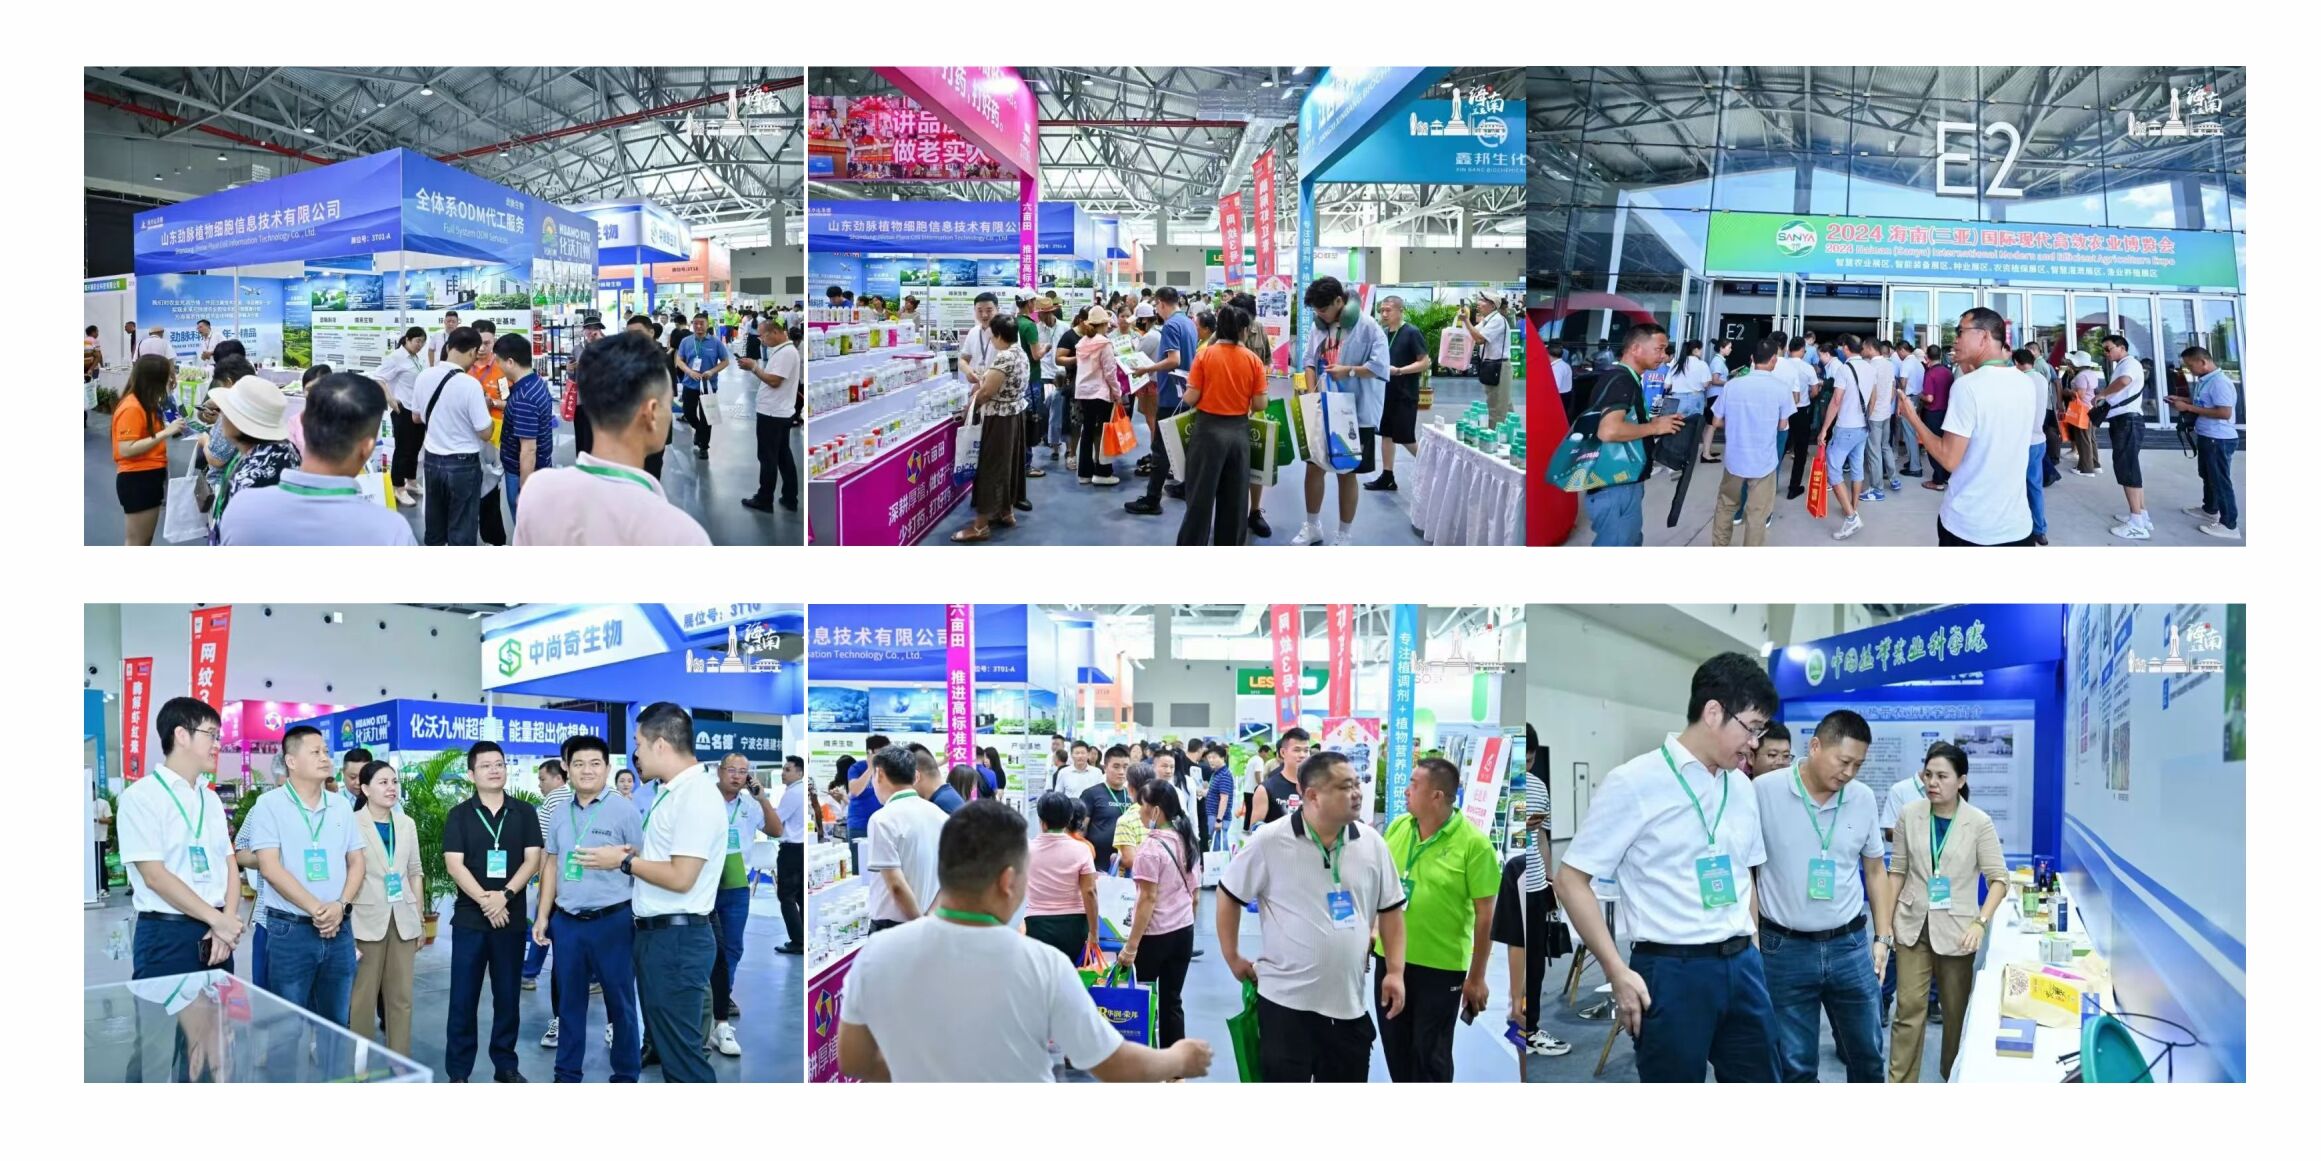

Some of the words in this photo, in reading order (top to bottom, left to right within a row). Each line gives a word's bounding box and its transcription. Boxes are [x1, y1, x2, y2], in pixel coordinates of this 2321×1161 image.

[892, 109, 955, 134] 讲品
[1456, 152, 1526, 167] 鑫邦生化
[1936, 120, 2024, 198] E2
[416, 187, 525, 235] 全体系ODM代工服务
[1022, 203, 1033, 231] 六亩田
[161, 199, 340, 246] 山东劲脉植物细胞信息技术有限公司
[828, 220, 1020, 233] 山东劲脉植物细胞信息技术有限公
[1778, 232, 1816, 244] SANYA
[1826, 223, 1883, 243] 2024
[1889, 224, 2176, 254] 海南(三亚)国际现代高效农业博览会
[559, 236, 592, 260] 化沃九州
[1825, 243, 1854, 254] 2024
[1932, 247, 1998, 259] International
[2037, 252, 2055, 261] and
[1214, 254, 1225, 262] LE
[170, 330, 203, 343] 劲脉科
[1726, 323, 1745, 341] E2
[923, 440, 945, 468] 六亩田
[529, 619, 622, 666] 中尚奇生物
[834, 649, 884, 662] Technology
[905, 650, 922, 660] Ltd.
[1249, 675, 1275, 689] LES
[951, 669, 967, 770] 推进高标准农
[1842, 705, 1983, 720] 热带农业科学院简介
[355, 725, 388, 743] 化沃九州
[711, 733, 733, 751] 名德
